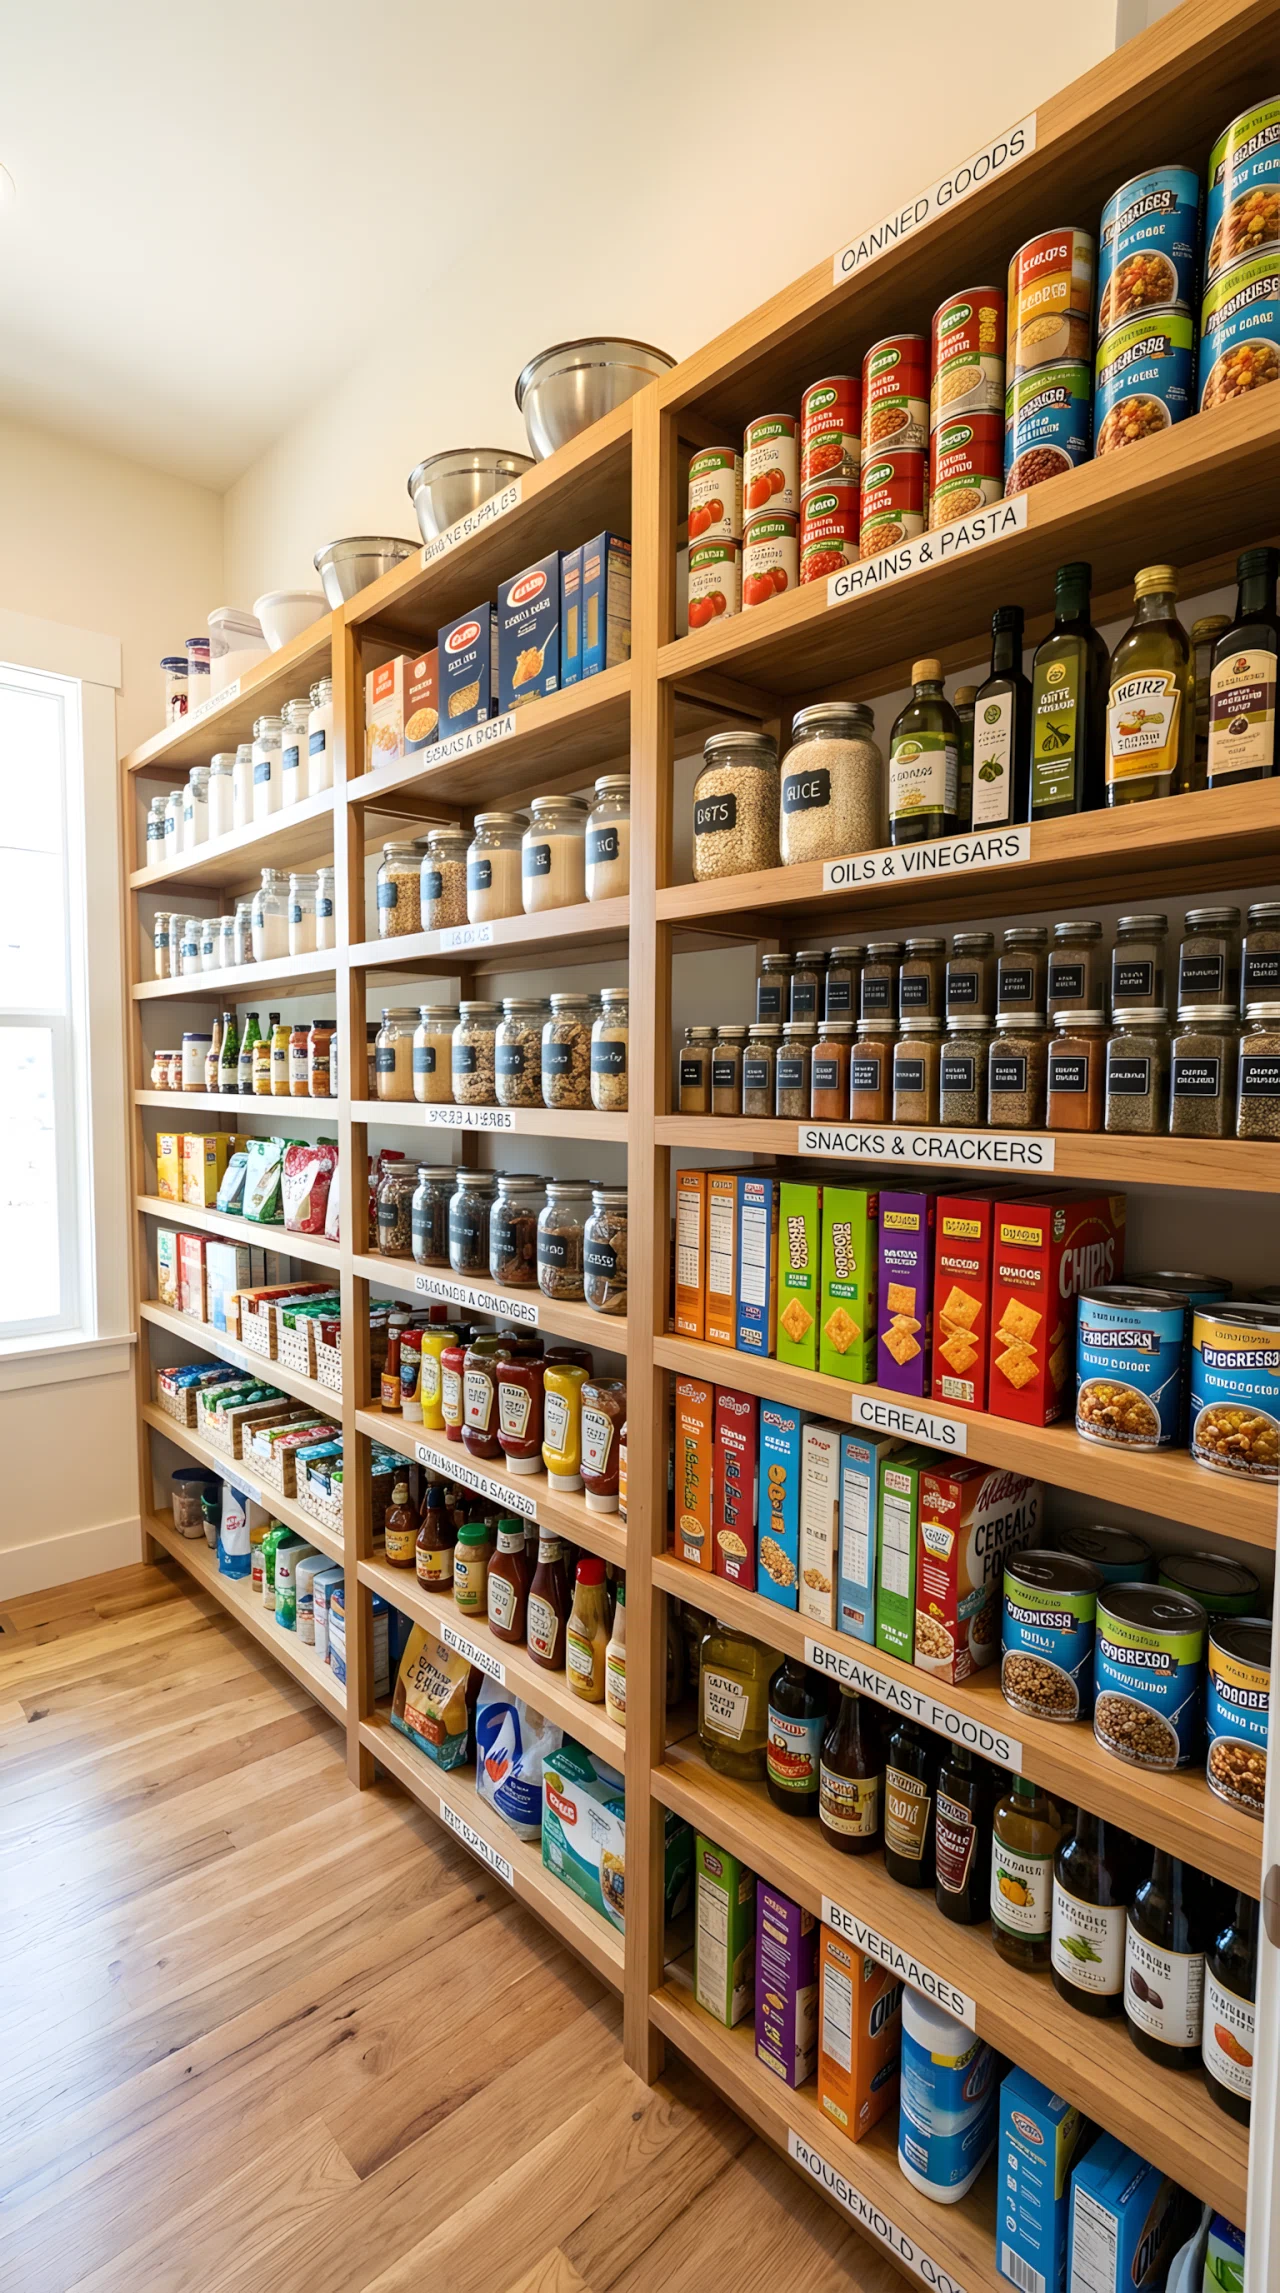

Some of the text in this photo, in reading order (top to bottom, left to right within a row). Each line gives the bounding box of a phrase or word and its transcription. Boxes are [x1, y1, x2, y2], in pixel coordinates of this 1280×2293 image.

[936, 129, 1025, 206] GOODS
[834, 506, 1017, 597] GRAINS & PASTA
[830, 835, 1020, 884] OILS & VINEGARS
[805, 1131, 1043, 1164] SNACKS & CRACKERS
[860, 1402, 956, 1444] CEREALS
[974, 1498, 1037, 1557] CEREALS
[812, 1646, 926, 1716] BREAKFAST
[932, 1706, 1010, 1760] FOODS
